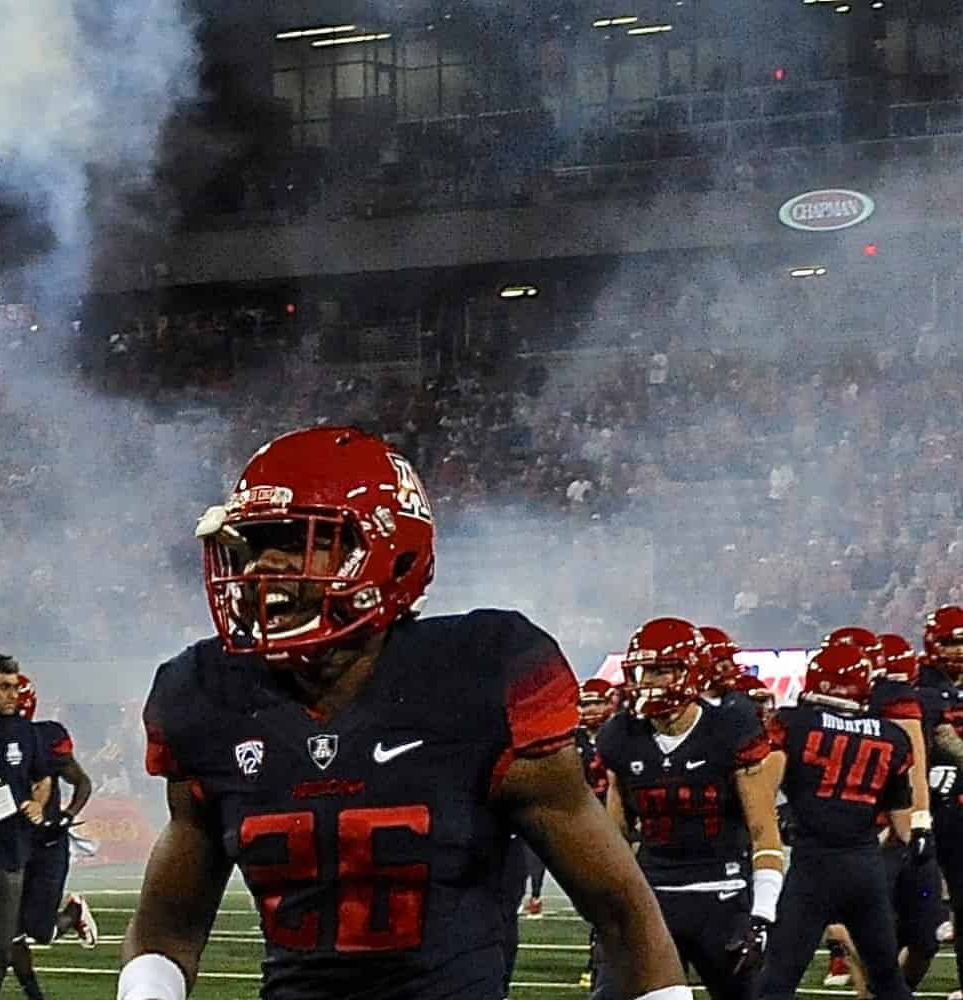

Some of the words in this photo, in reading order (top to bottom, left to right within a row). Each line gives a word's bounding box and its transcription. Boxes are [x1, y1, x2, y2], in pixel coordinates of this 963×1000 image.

[793, 199, 859, 220] CHAPMAN
[822, 711, 881, 737] MURPHY
[803, 730, 894, 804] 40
[241, 805, 430, 951] 26
